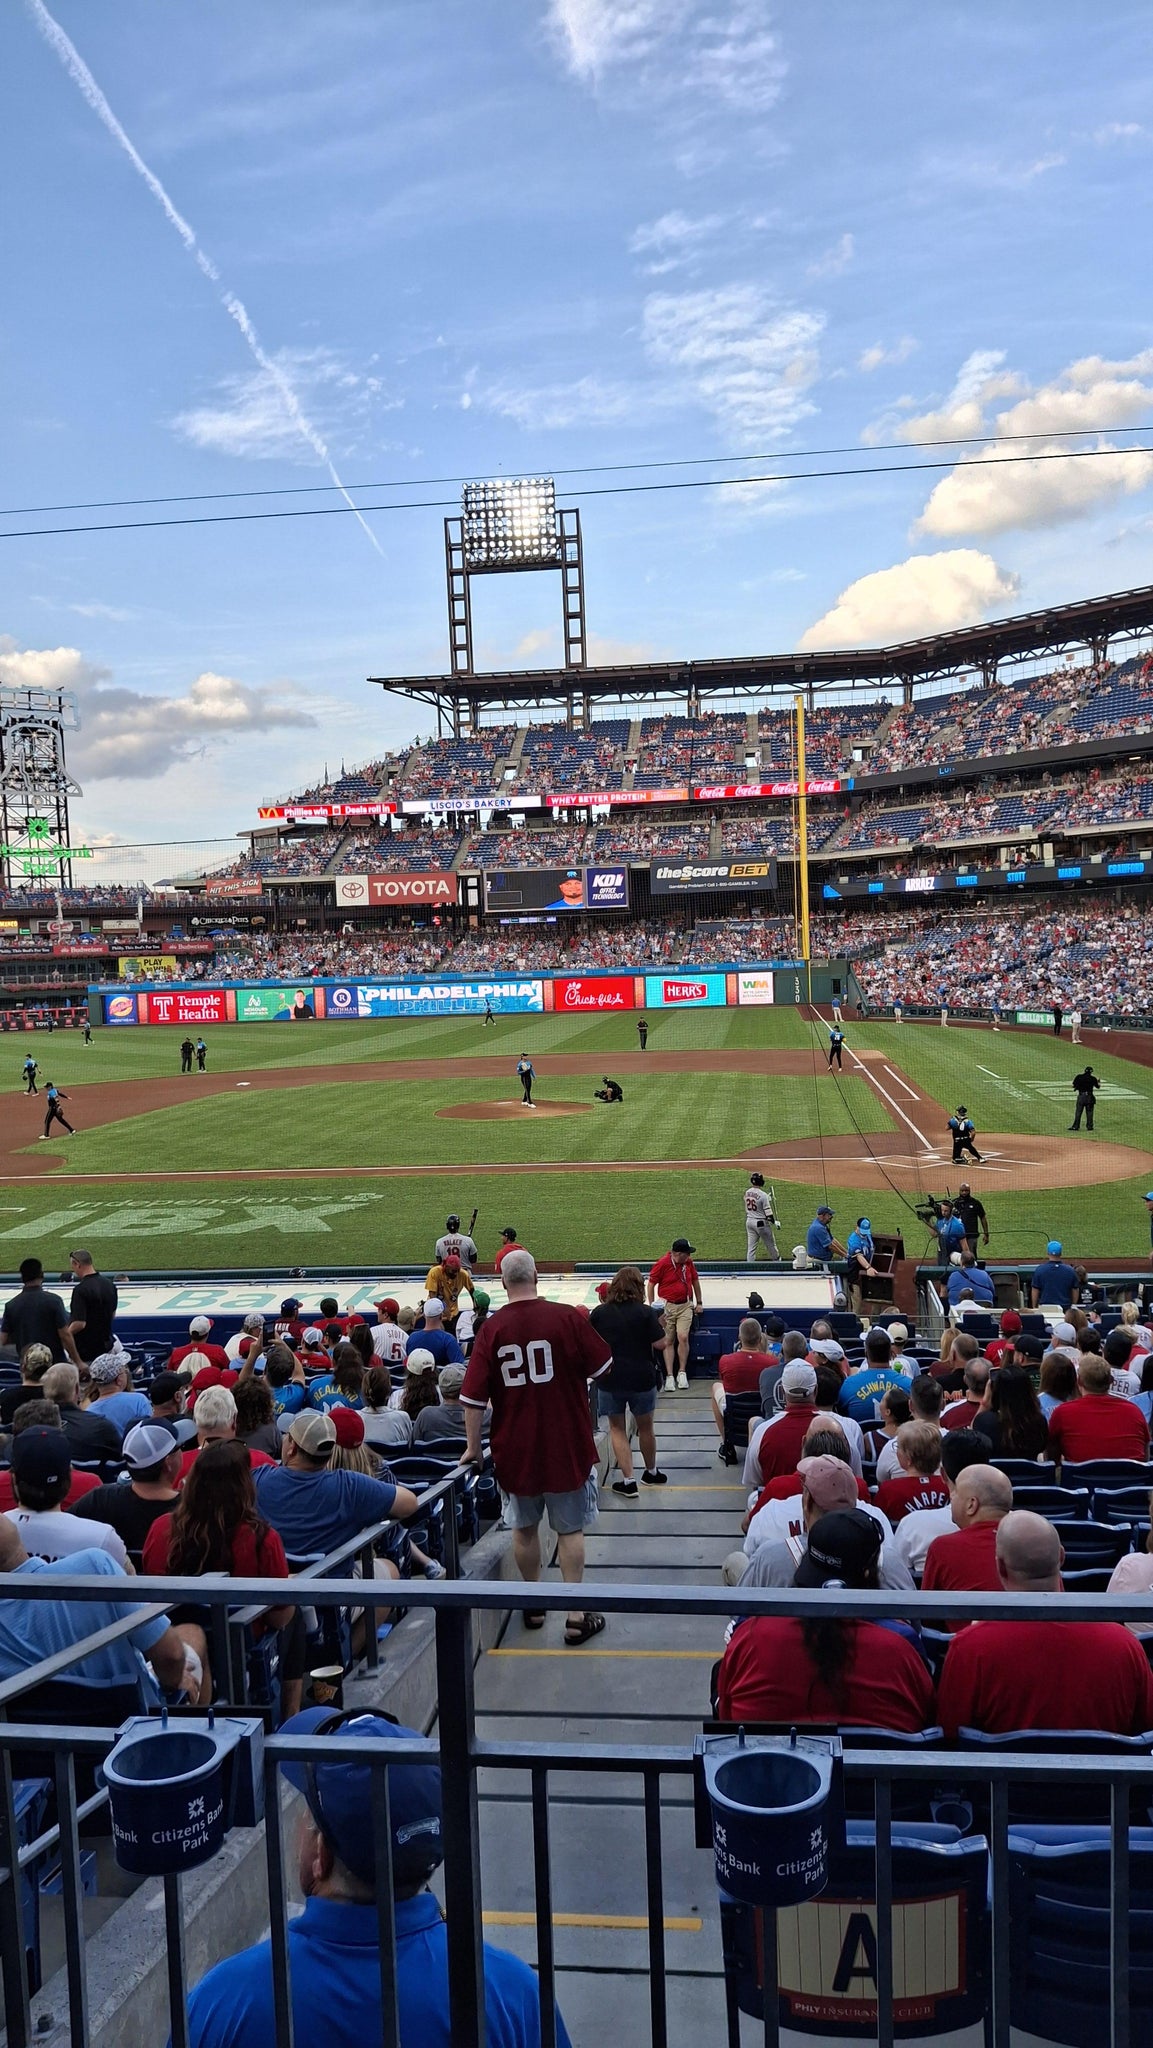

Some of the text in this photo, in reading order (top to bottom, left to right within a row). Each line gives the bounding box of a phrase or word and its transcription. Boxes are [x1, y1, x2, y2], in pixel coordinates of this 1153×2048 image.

[699, 787, 727, 799] Coca-Cola
[735, 785, 762, 797] Coca-Cola
[808, 781, 835, 793] Coca-Cola
[430, 799, 512, 810] LISCIO'S BAKERY
[551, 796, 576, 805] WHEY
[579, 794, 608, 803] BETTER
[611, 793, 647, 801] PROTEIN
[284, 803, 390, 817] Phillies win Deals roll in
[656, 865, 766, 879] theScore BET
[224, 882, 240, 892] THIS
[241, 879, 260, 887] SIGN
[373, 880, 450, 897] TOYOTA
[905, 877, 935, 891] ARRAEZ
[1007, 872, 1026, 882] STOTT
[143, 958, 163, 966] PLAY
[667, 984, 702, 998] HERR'S
[743, 980, 768, 989] WM
[365, 983, 535, 1001] PHILADELPHIA
[565, 984, 624, 1006] Chick-fil-A
[177, 995, 221, 1009] Temple
[398, 997, 502, 1013] PHILLIES
[178, 1009, 219, 1020] Health
[68, 1195, 333, 1209] Independence
[746, 1198, 758, 1211] 26
[156, 1285, 403, 1311] Bank
[391, 1342, 402, 1359] 5
[497, 1339, 554, 1387] 20
[944, 1389, 963, 1401] MIL
[1111, 1381, 1130, 1395] PER
[152, 1798, 224, 1844] Citizens Bank
[114, 1823, 139, 1844] Bank
[182, 1830, 210, 1853] Park
[728, 1853, 761, 1876] Bank
[776, 1849, 823, 1876] Citizens
[805, 1861, 825, 1885] Park
[832, 1913, 880, 1993] A
[795, 2002, 932, 2018] PHLY INSURAN CLUB
